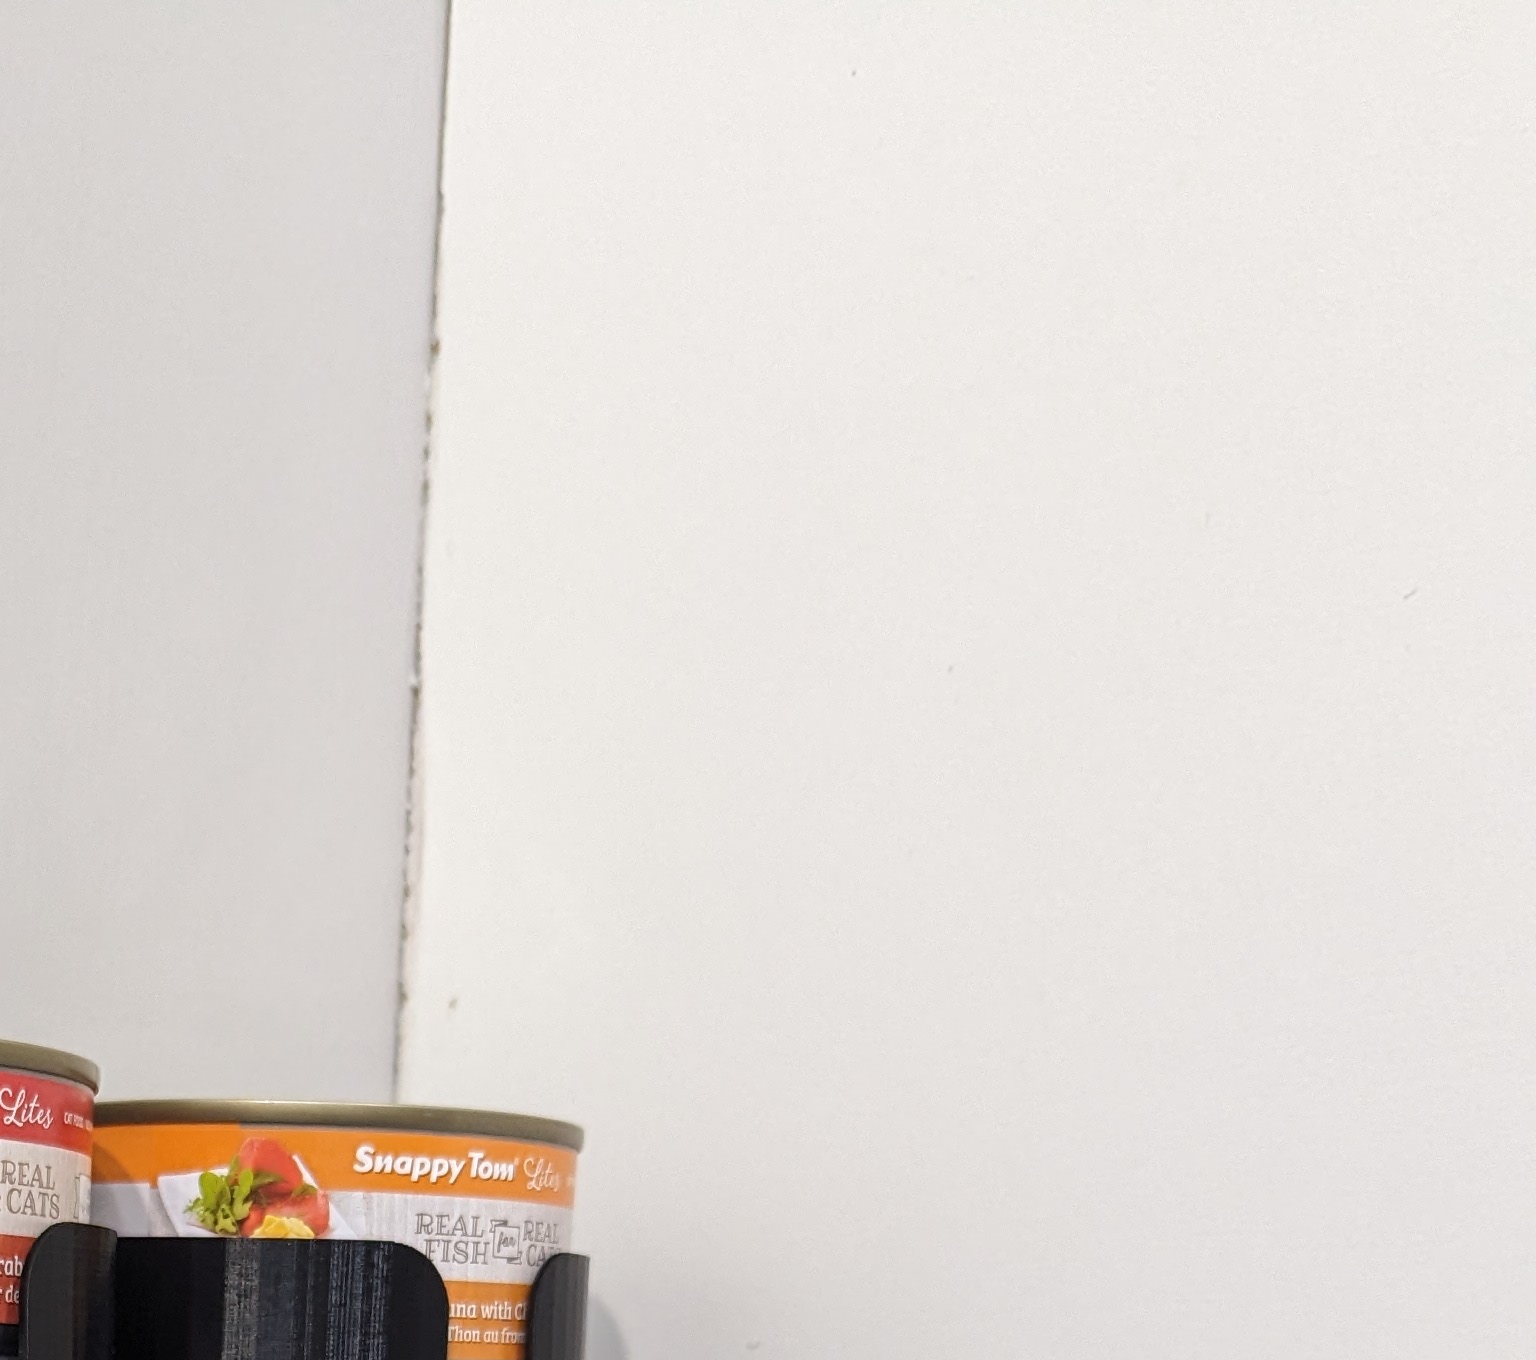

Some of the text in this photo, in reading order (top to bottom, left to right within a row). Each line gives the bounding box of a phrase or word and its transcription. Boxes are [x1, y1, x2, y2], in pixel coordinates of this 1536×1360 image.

[0, 1087, 54, 1129] Lites
[0, 1160, 56, 1190] REAL
[353, 1145, 466, 1184] Snappy
[523, 1158, 560, 1193] Lites
[7, 1188, 60, 1220] CATS
[415, 1212, 486, 1238] REAL
[523, 1219, 560, 1244] REAL
[425, 1239, 560, 1268] FISH CA
[480, 1300, 512, 1320] with
[448, 1325, 480, 1343] Thon
[484, 1330, 499, 1343] au
